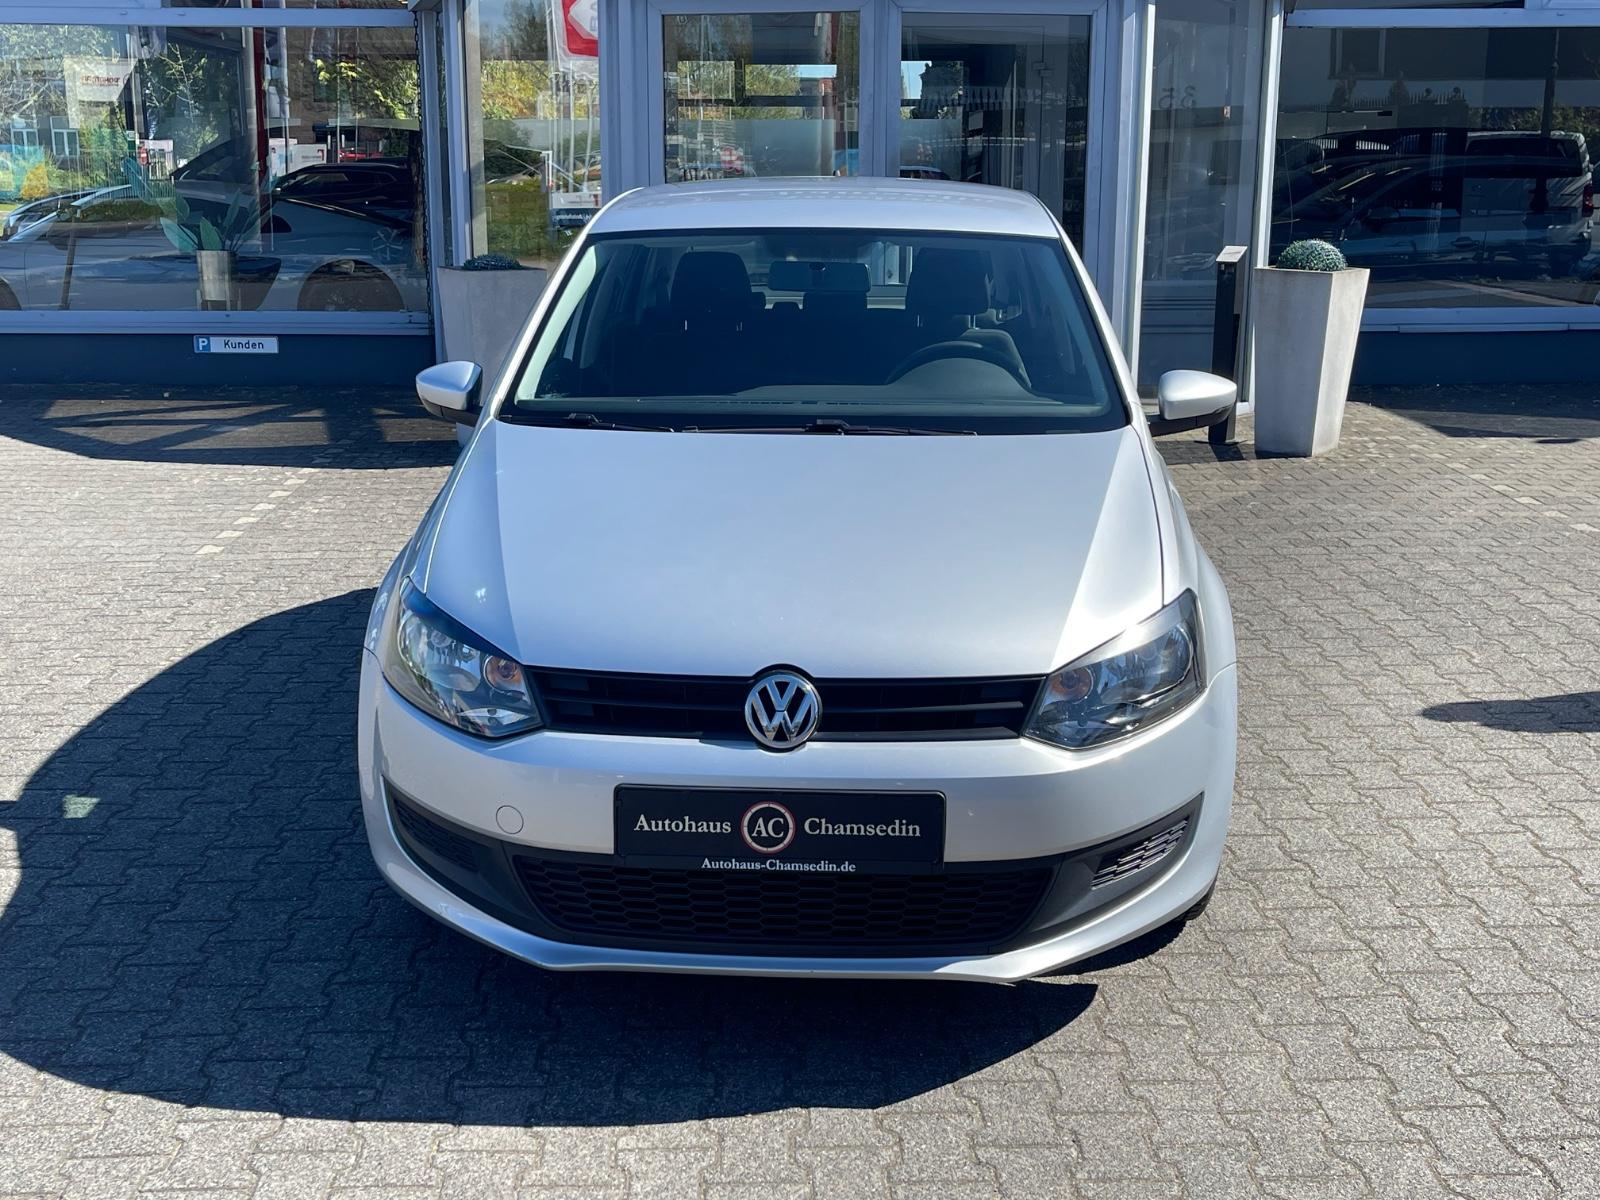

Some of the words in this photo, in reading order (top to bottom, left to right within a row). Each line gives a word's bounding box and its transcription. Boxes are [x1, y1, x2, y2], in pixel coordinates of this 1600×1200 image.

[198, 338, 209, 351] P
[223, 339, 264, 350] Kunden
[633, 814, 732, 835] Autohaus
[751, 817, 786, 839] AC
[803, 817, 922, 838] Chamsedin
[701, 858, 857, 874] Autohaus-Chamsedin.de
